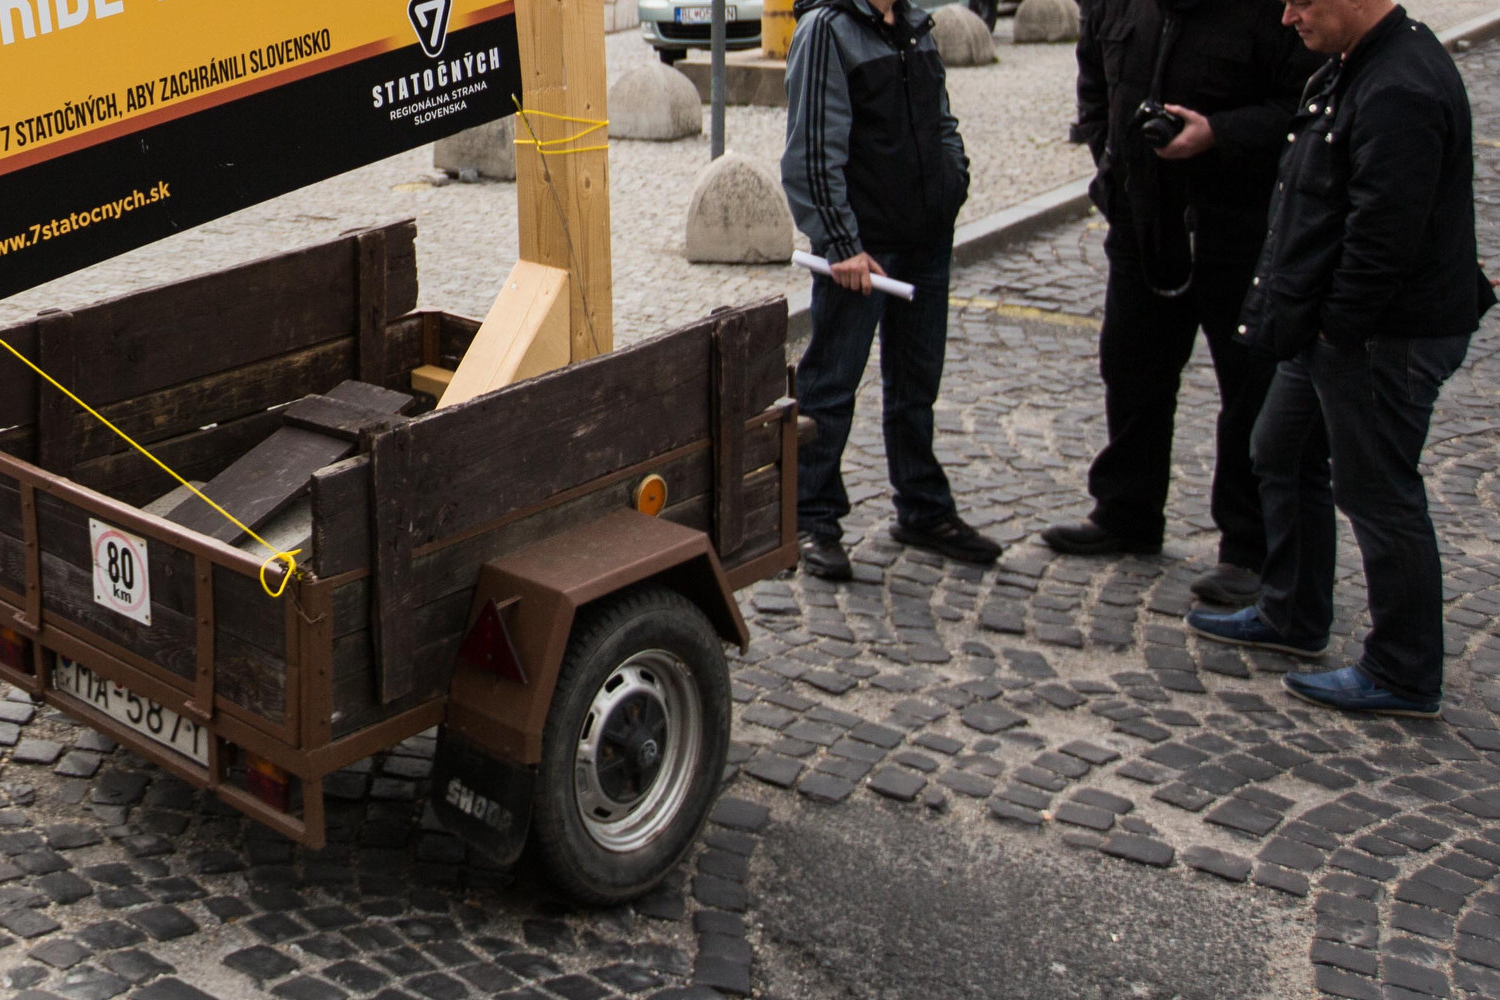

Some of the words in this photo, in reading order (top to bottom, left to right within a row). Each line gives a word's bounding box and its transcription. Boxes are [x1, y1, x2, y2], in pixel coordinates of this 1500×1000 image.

[0, 126, 11, 152] 7
[16, 92, 124, 147] STATOČNÝCH,
[126, 81, 156, 113] ABY
[159, 53, 247, 102] ZACHRÁNILI
[250, 28, 332, 74] SLOVENSKO
[389, 93, 450, 121] REGIONÁLNA
[451, 80, 488, 100] STRANA
[414, 100, 467, 126] SLOVENSKA
[107, 541, 134, 590] 80
[112, 583, 132, 604] km
